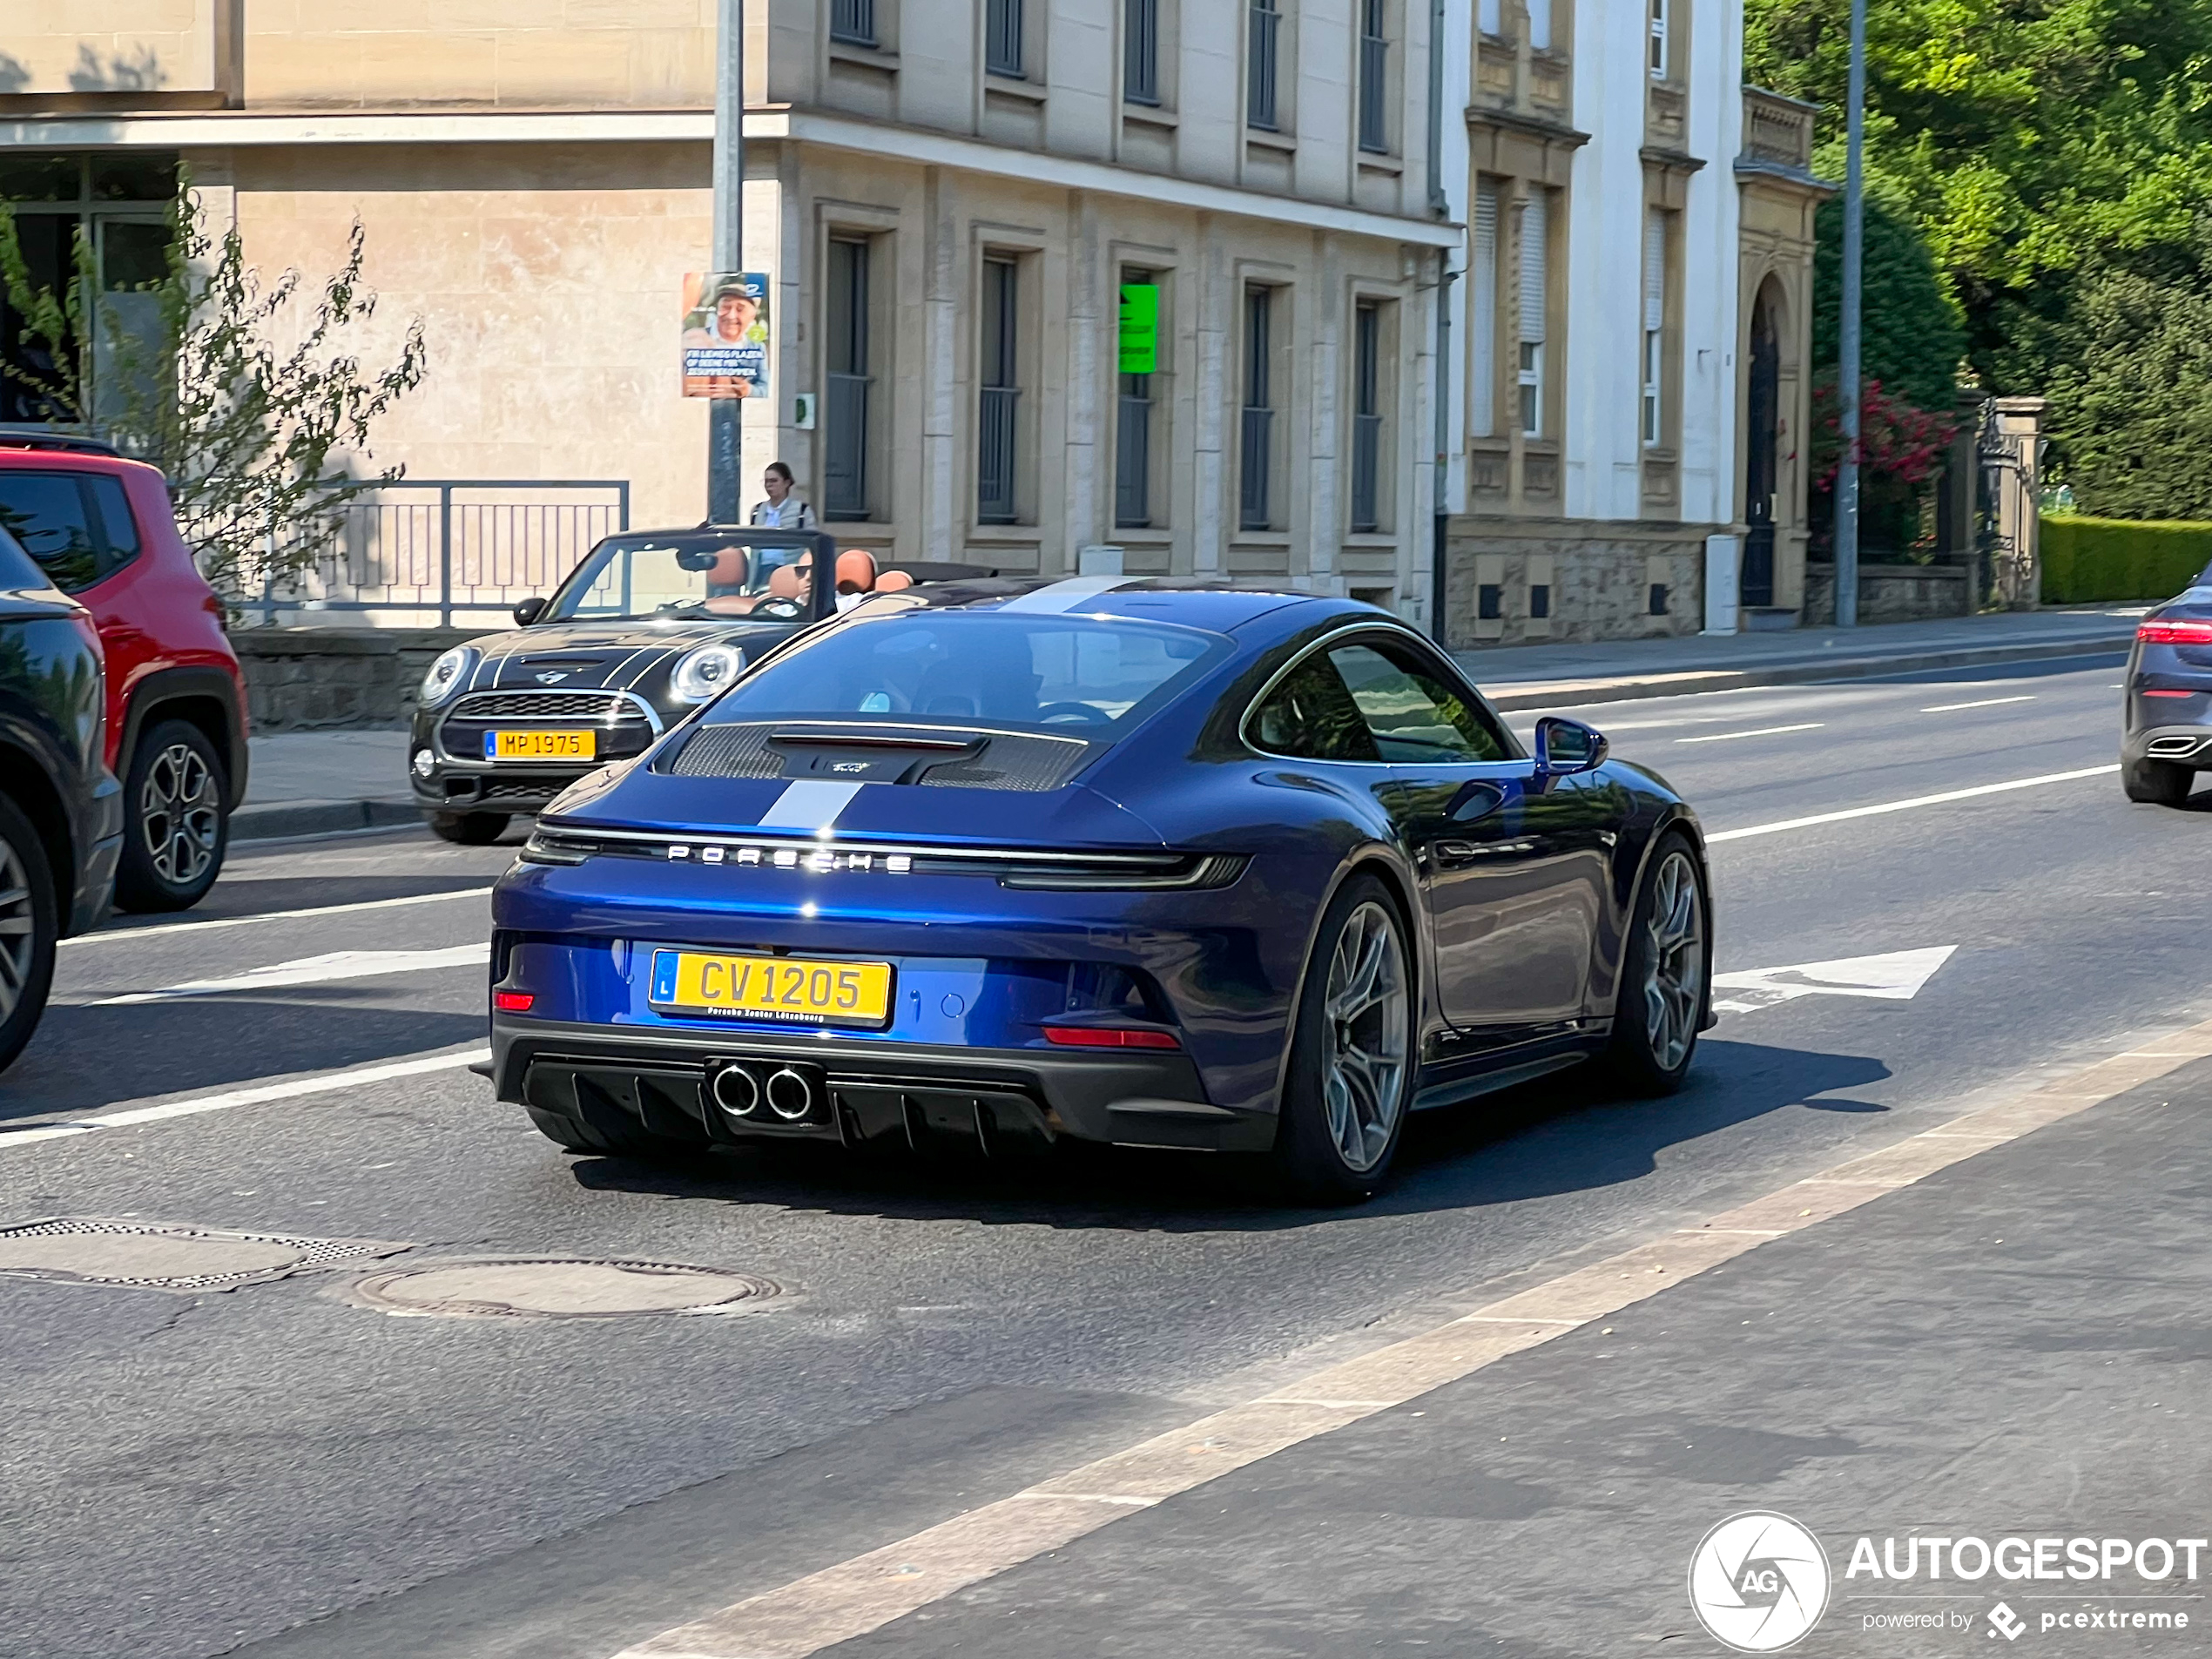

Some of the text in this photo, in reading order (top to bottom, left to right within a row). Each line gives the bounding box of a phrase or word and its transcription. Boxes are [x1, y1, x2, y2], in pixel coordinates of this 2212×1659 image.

[668, 846, 912, 872] PORSCHE
[660, 981, 668, 995] L
[707, 1007, 742, 1016] Porsche
